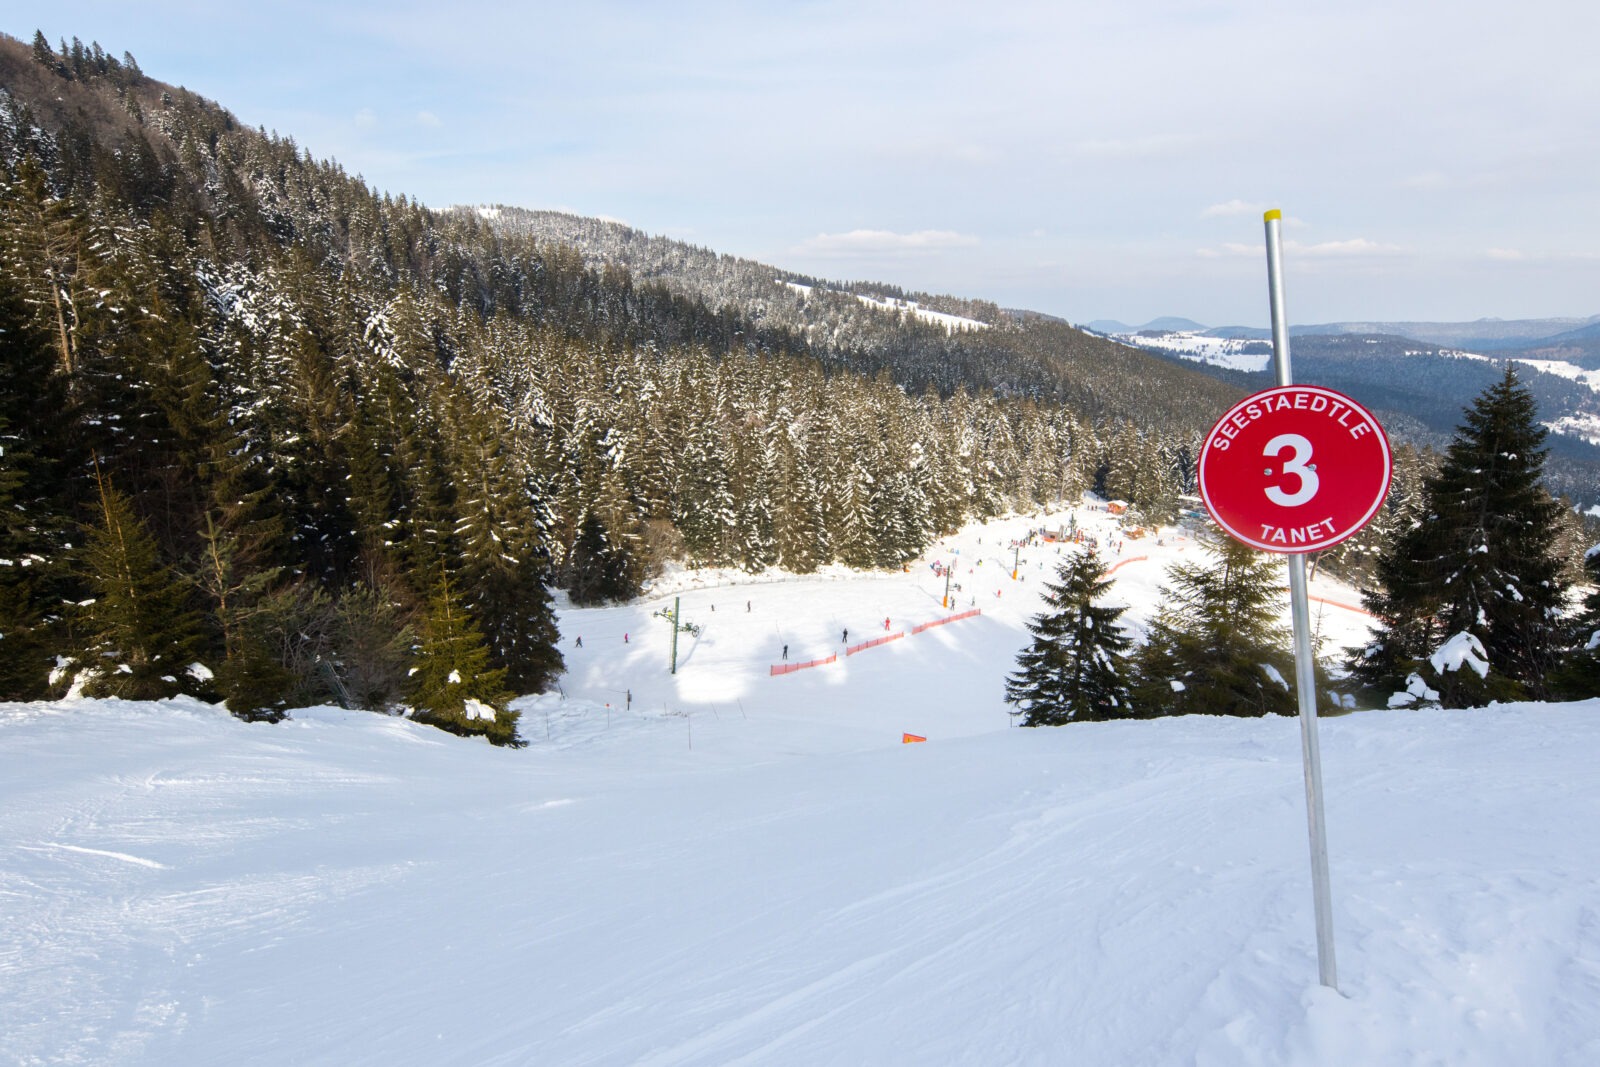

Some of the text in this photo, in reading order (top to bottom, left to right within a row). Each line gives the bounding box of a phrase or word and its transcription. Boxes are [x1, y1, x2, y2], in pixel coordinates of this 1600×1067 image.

[1213, 393, 1371, 451] SEESTAEDTLE
[1262, 433, 1320, 507] 3
[1260, 517, 1338, 544] TANET
